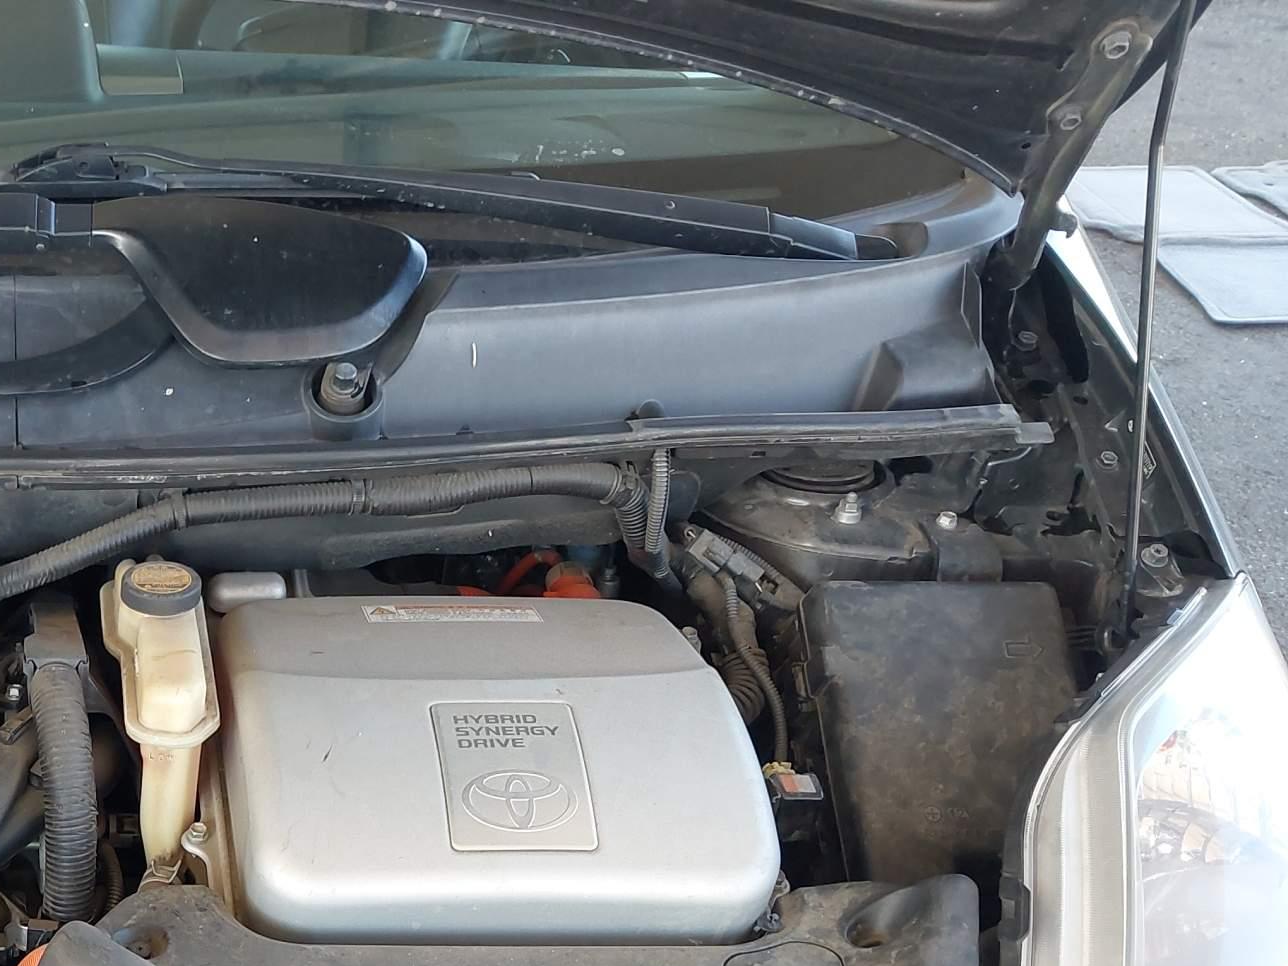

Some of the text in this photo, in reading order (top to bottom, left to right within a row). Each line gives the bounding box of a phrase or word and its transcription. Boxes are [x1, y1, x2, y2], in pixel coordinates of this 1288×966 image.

[453, 714, 537, 724] HYBRID
[455, 725, 559, 736] SYNERGY
[458, 738, 526, 748] DRIVE
